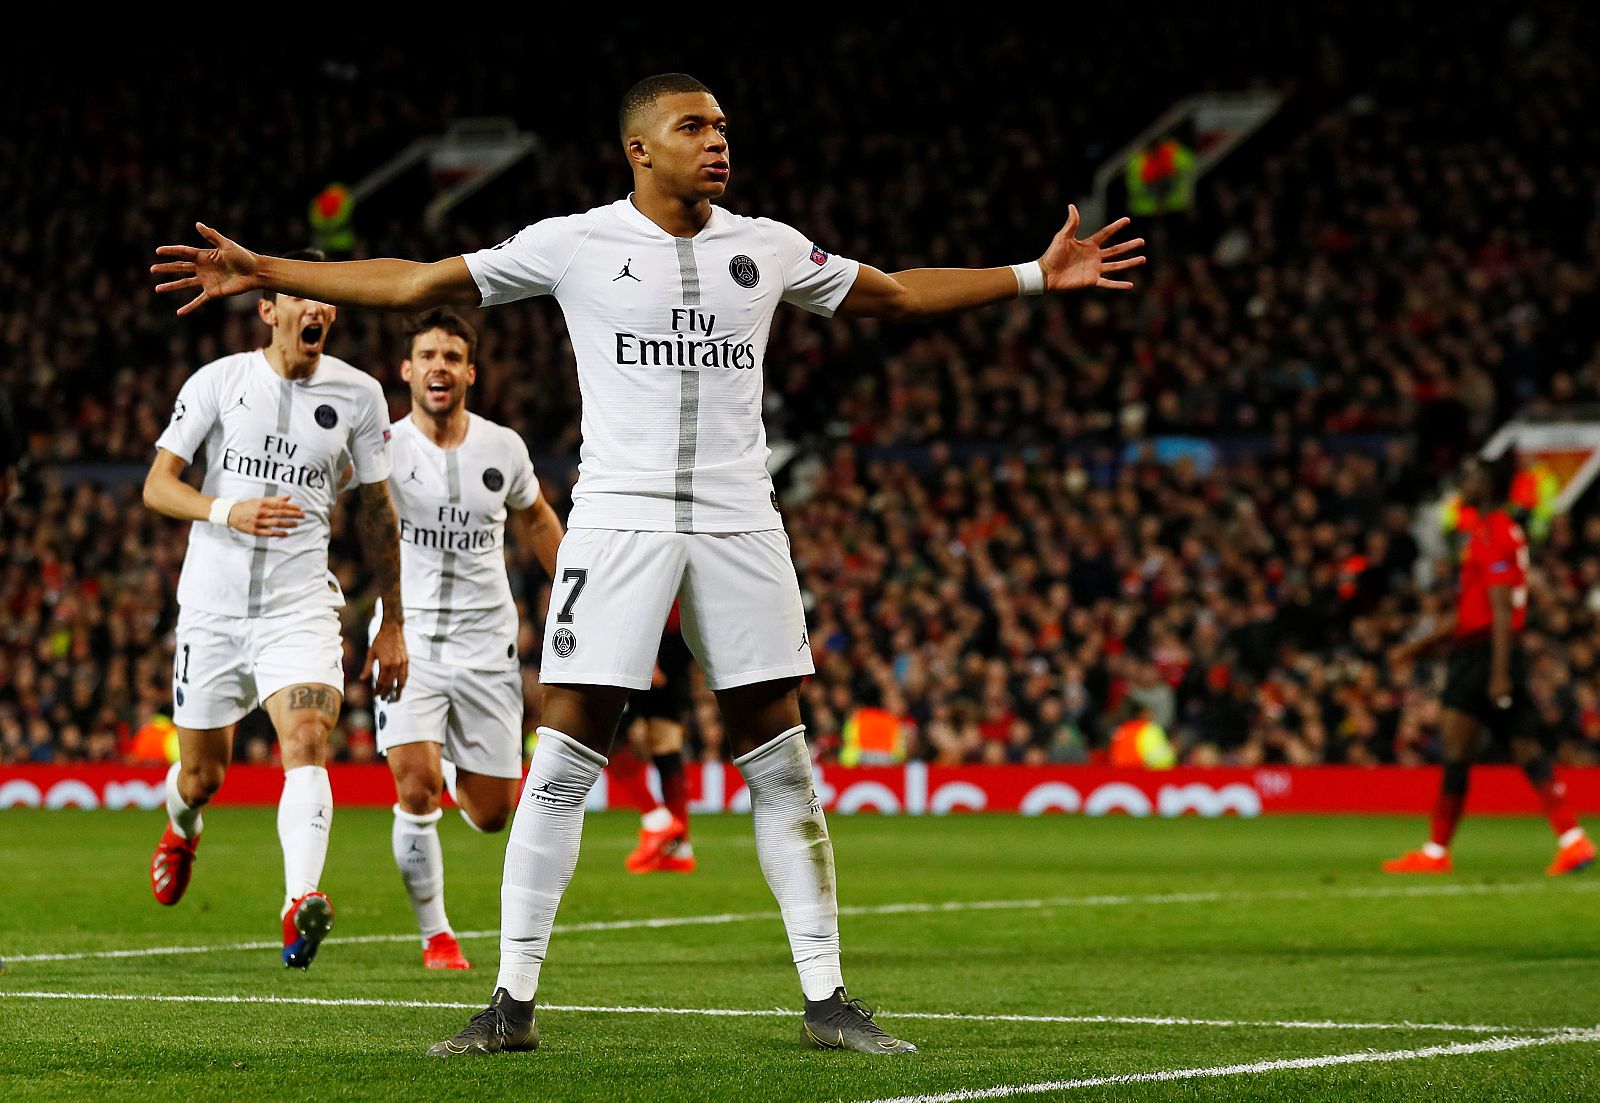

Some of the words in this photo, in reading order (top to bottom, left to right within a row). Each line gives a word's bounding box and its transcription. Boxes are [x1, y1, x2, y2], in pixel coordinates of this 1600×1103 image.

[671, 308, 716, 337] Fly
[614, 332, 755, 370] Emirates
[264, 435, 298, 459] Fly
[222, 448, 327, 490] Emirates
[437, 506, 470, 527] Fly
[400, 519, 496, 551] Emirates
[556, 567, 589, 625] 7
